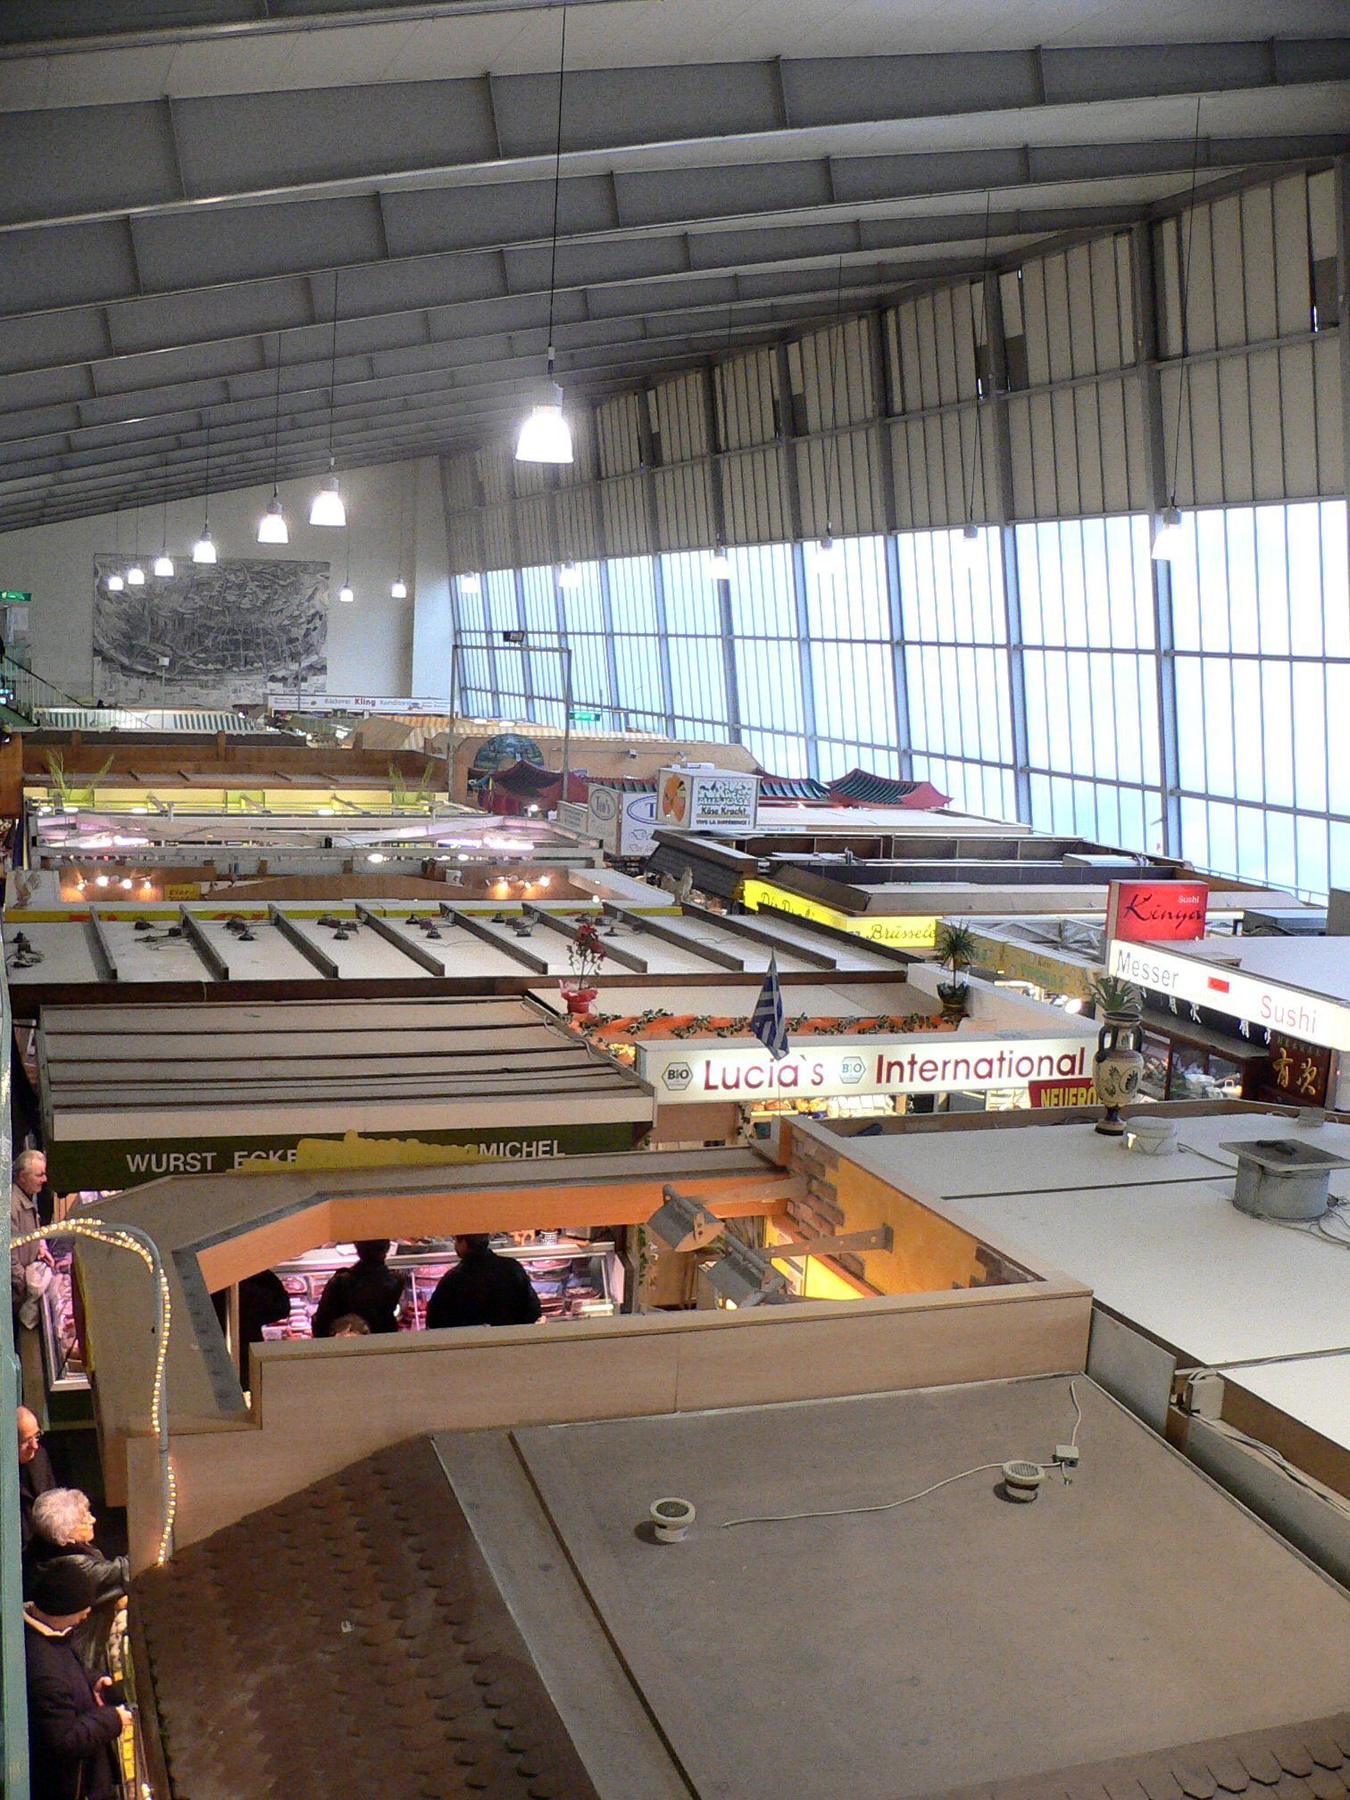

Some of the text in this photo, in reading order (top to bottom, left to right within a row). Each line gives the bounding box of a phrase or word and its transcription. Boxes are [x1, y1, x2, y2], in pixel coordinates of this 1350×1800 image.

[355, 698, 376, 707] Kling
[1125, 894, 1204, 929] Kinya
[1178, 895, 1200, 905] Sushi
[1115, 949, 1180, 989] Messer
[1260, 995, 1317, 1034] Sushi
[876, 1046, 1085, 1085] International
[126, 1152, 217, 1173] WURST
[480, 1140, 566, 1159] MICHEL
